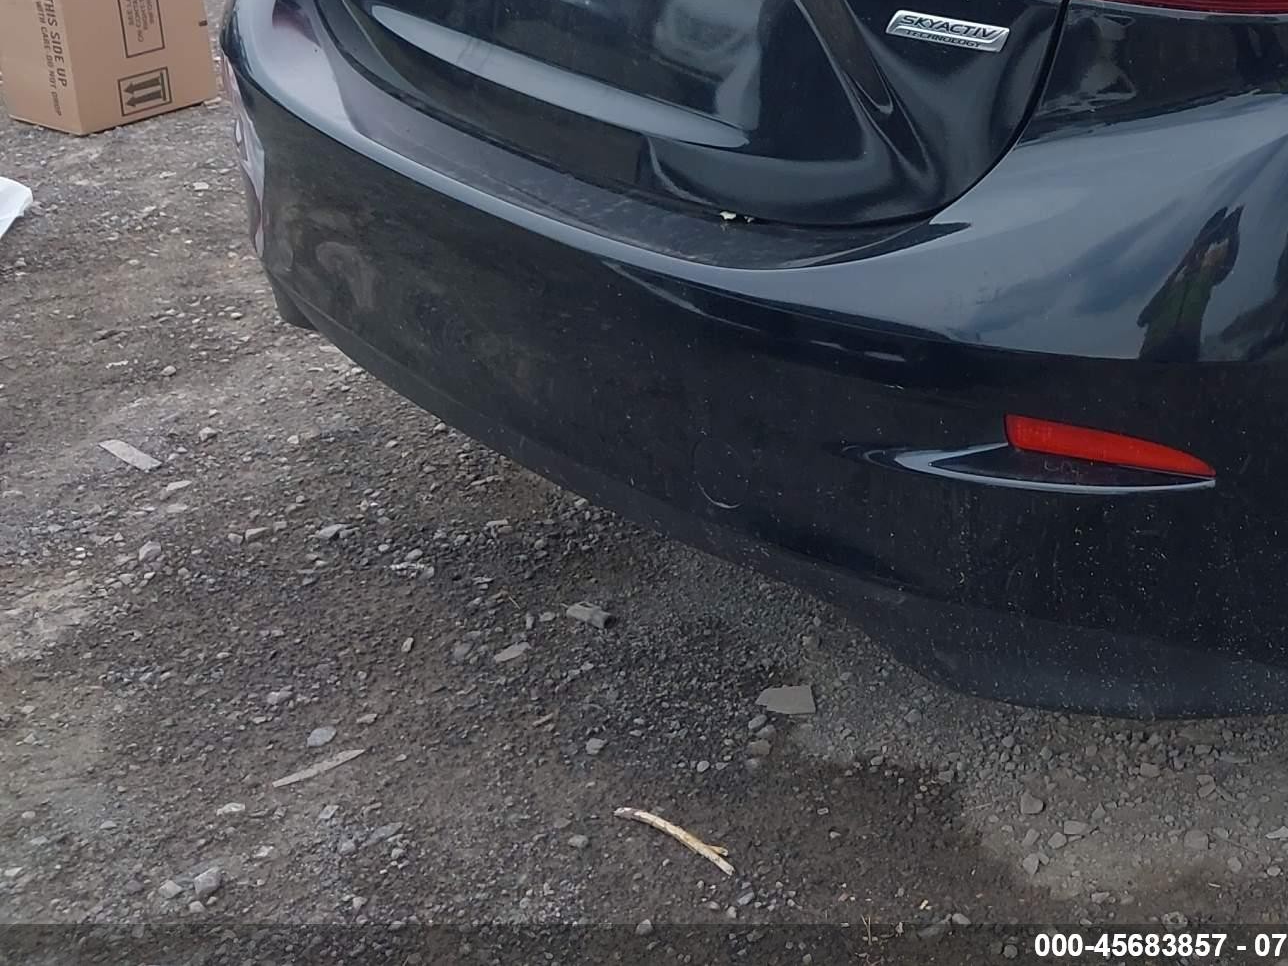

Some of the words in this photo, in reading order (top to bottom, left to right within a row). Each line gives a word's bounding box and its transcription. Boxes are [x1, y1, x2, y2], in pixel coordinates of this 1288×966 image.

[35, 1, 47, 24] WITH
[900, 15, 996, 38] SKYACTIV
[41, 26, 51, 50] CARE
[50, 30, 65, 64] SIDE
[906, 30, 982, 48] TECHNOLOGY
[46, 55, 54, 68] DO
[49, 70, 57, 89] NOT
[57, 68, 68, 88] UP
